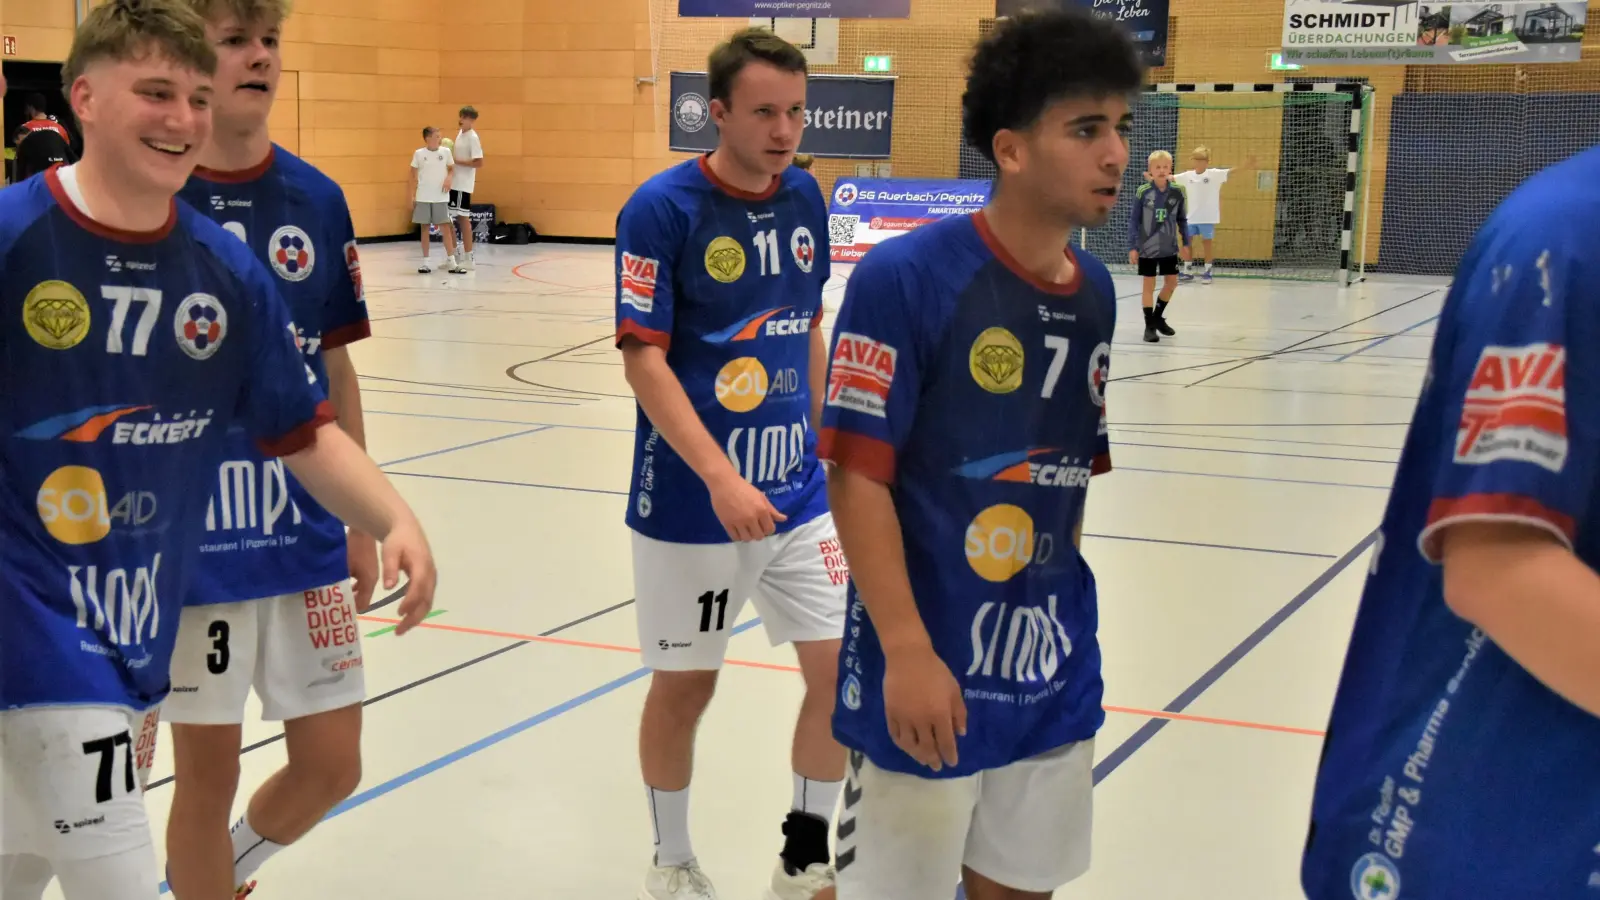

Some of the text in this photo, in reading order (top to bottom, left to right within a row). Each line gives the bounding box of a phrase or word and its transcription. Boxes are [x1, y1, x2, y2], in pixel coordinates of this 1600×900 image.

[754, 1, 831, 10] www.optiker-pegnitz.de
[1116, 6, 1150, 21] Leben
[1289, 12, 1390, 29] SCHMIDT
[1288, 32, 1416, 44] ÜBERDACHUNGEN
[858, 191, 985, 205] SG Auerbach/Pegnitz
[126, 259, 156, 271] spized
[753, 229, 781, 276] 11
[100, 285, 163, 356] 77
[834, 338, 894, 376] AVIA
[1040, 334, 1070, 399] 7
[112, 418, 211, 445] ECKERT
[36, 488, 157, 526] SOLAID
[303, 586, 344, 609] BUS
[697, 588, 729, 632] 11
[307, 604, 352, 629] DICH
[206, 620, 231, 675] 3
[1397, 786, 1421, 806] &
[1384, 805, 1414, 858] GMP
